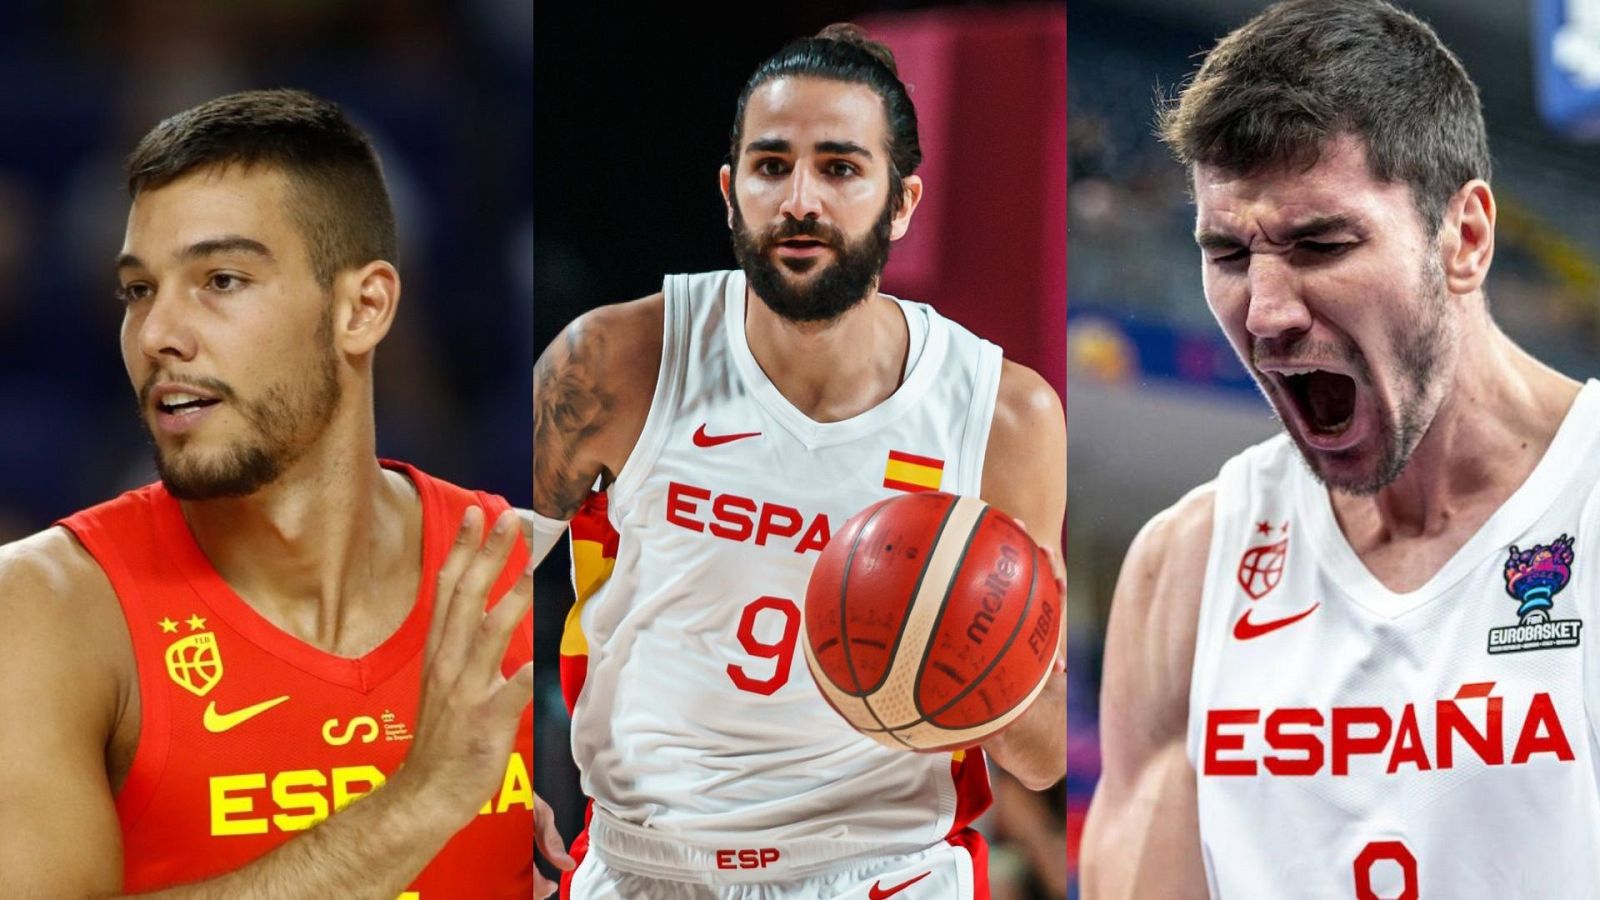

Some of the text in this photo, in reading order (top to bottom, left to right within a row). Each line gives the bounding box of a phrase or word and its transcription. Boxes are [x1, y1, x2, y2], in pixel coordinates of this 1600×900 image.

[667, 481, 831, 554] ESPA
[966, 544, 1019, 645] molten
[1028, 600, 1054, 655] FIBA
[726, 596, 802, 696] 9
[1490, 621, 1581, 646] EUROBASKET
[1204, 682, 1575, 776] ESPAÑA
[716, 847, 780, 870] ESP
